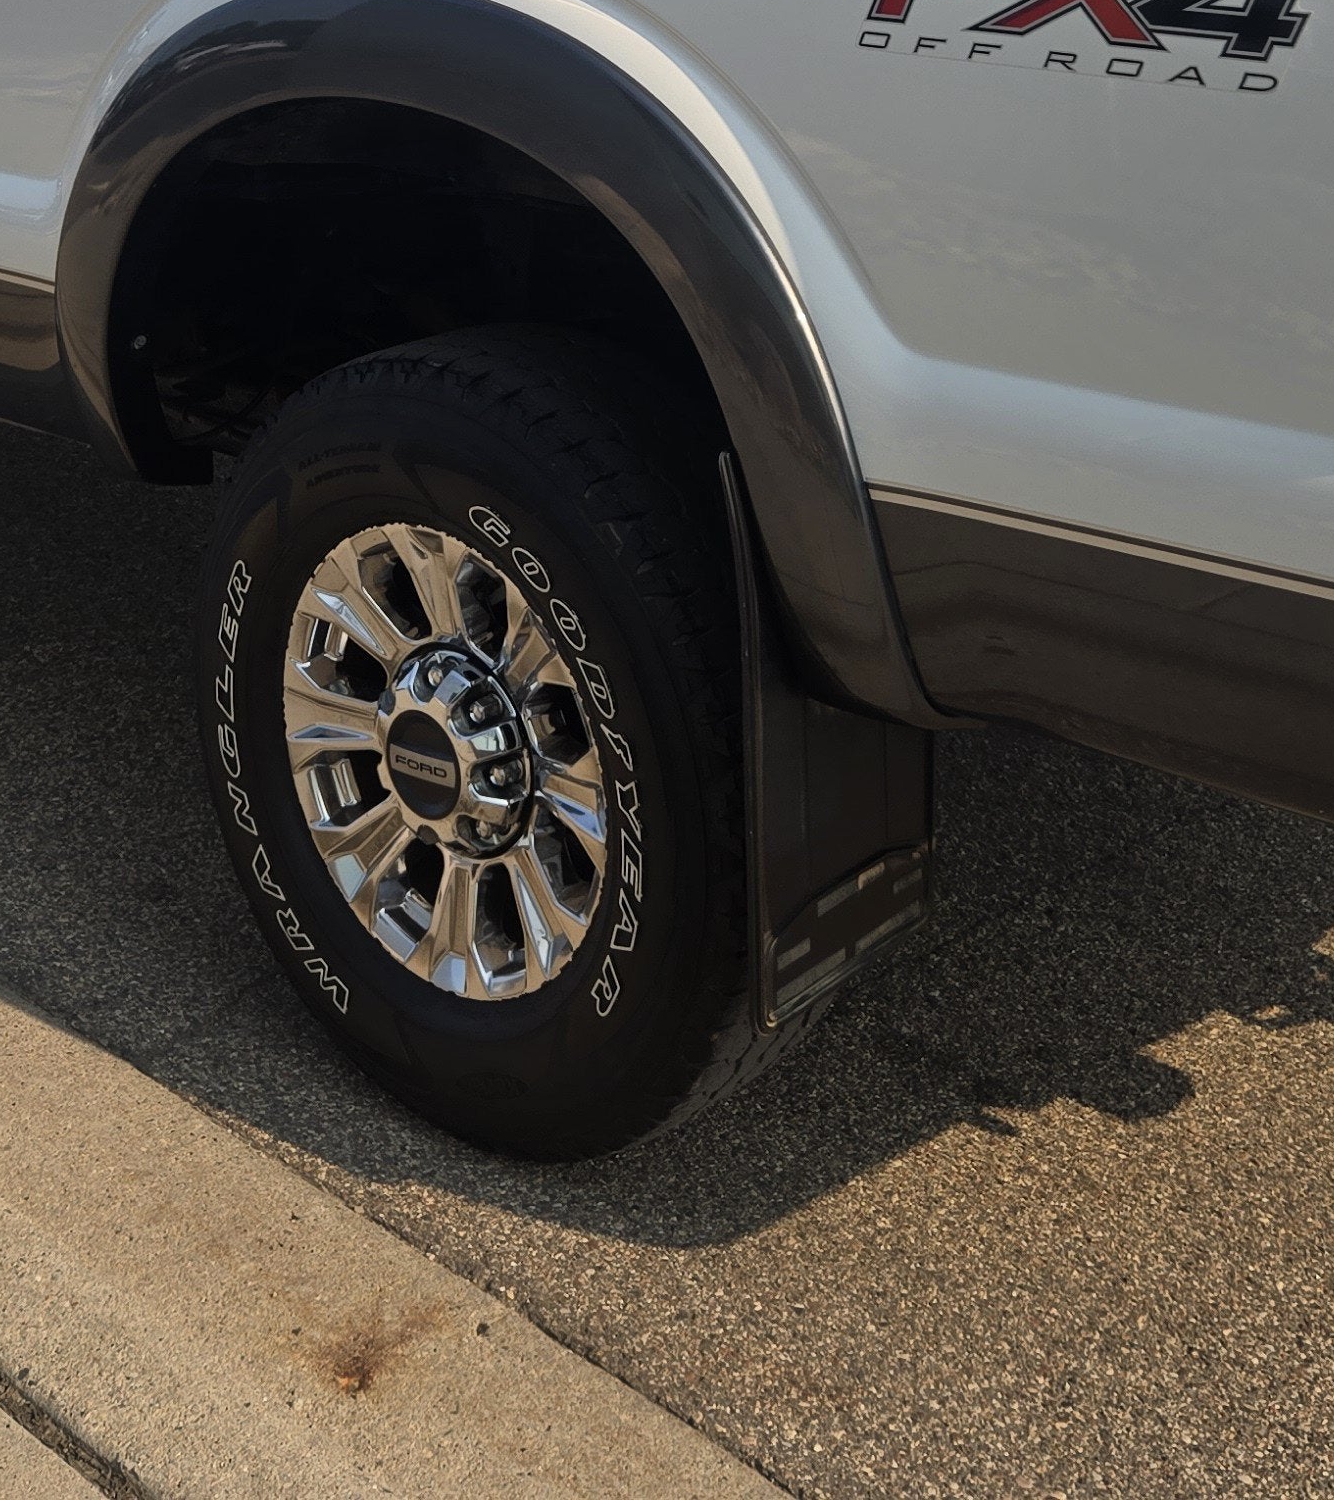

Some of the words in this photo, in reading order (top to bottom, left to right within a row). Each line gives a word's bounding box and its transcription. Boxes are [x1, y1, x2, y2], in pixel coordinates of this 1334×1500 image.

[857, 30, 1003, 60] OFF
[1043, 51, 1278, 92] ROAD
[215, 559, 350, 1014] WRANGLER
[395, 754, 448, 779] FORD
[469, 505, 644, 1017] GOODYEAR
